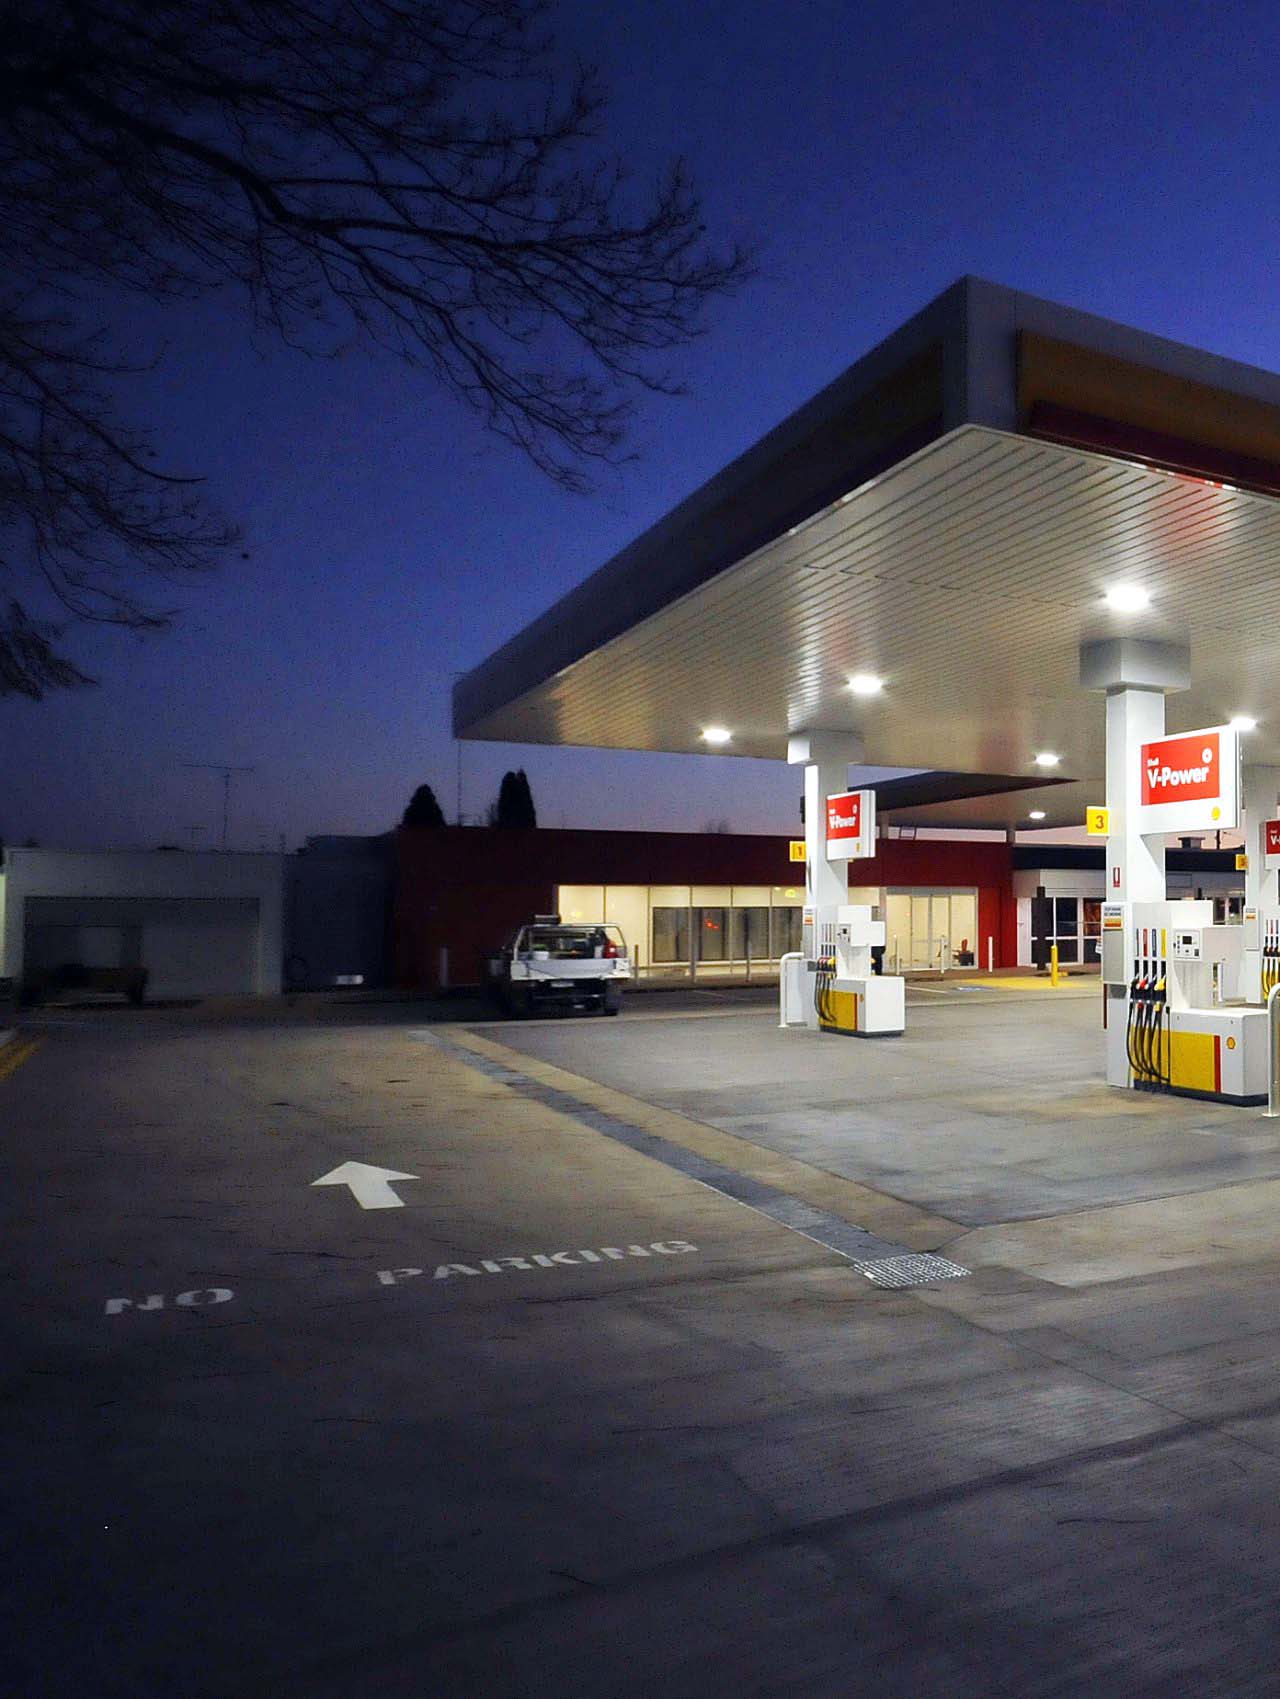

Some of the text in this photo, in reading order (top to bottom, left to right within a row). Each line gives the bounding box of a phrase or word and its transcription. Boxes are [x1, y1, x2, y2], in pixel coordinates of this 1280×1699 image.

[1147, 767, 1209, 788] V-Power
[1096, 815, 1104, 829] 3
[105, 1240, 699, 1315] NO PARKING
